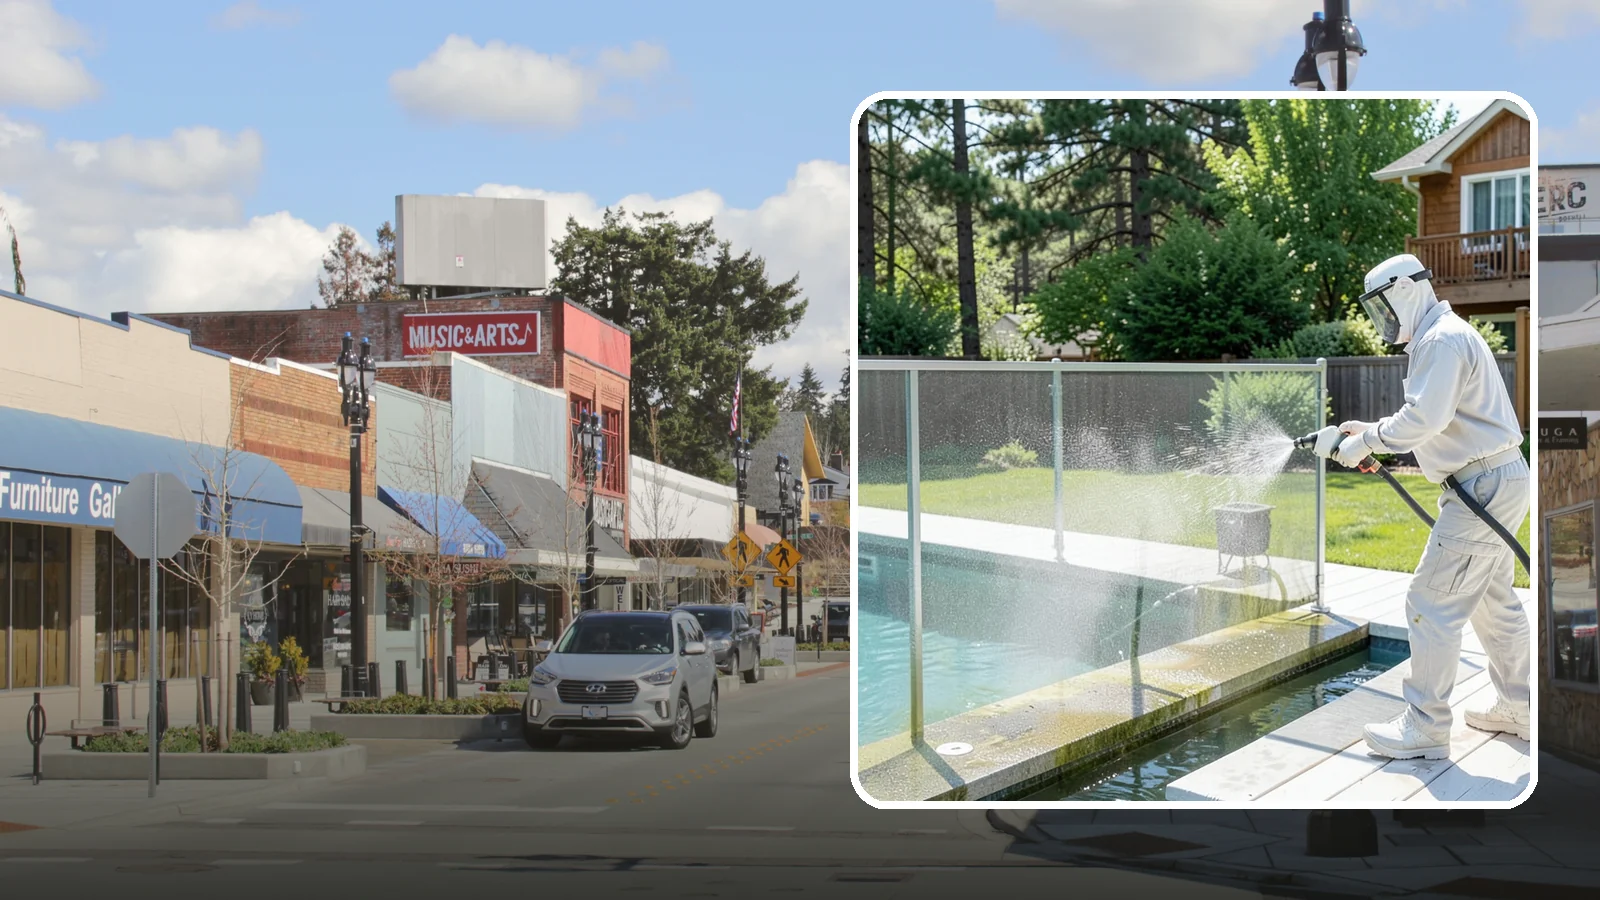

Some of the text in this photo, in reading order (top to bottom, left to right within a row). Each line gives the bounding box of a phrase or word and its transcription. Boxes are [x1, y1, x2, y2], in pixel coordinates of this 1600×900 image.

[409, 323, 519, 349] MUSIC&ARTS
[0, 472, 79, 515] Furniture
[453, 563, 480, 574] SUSHI
